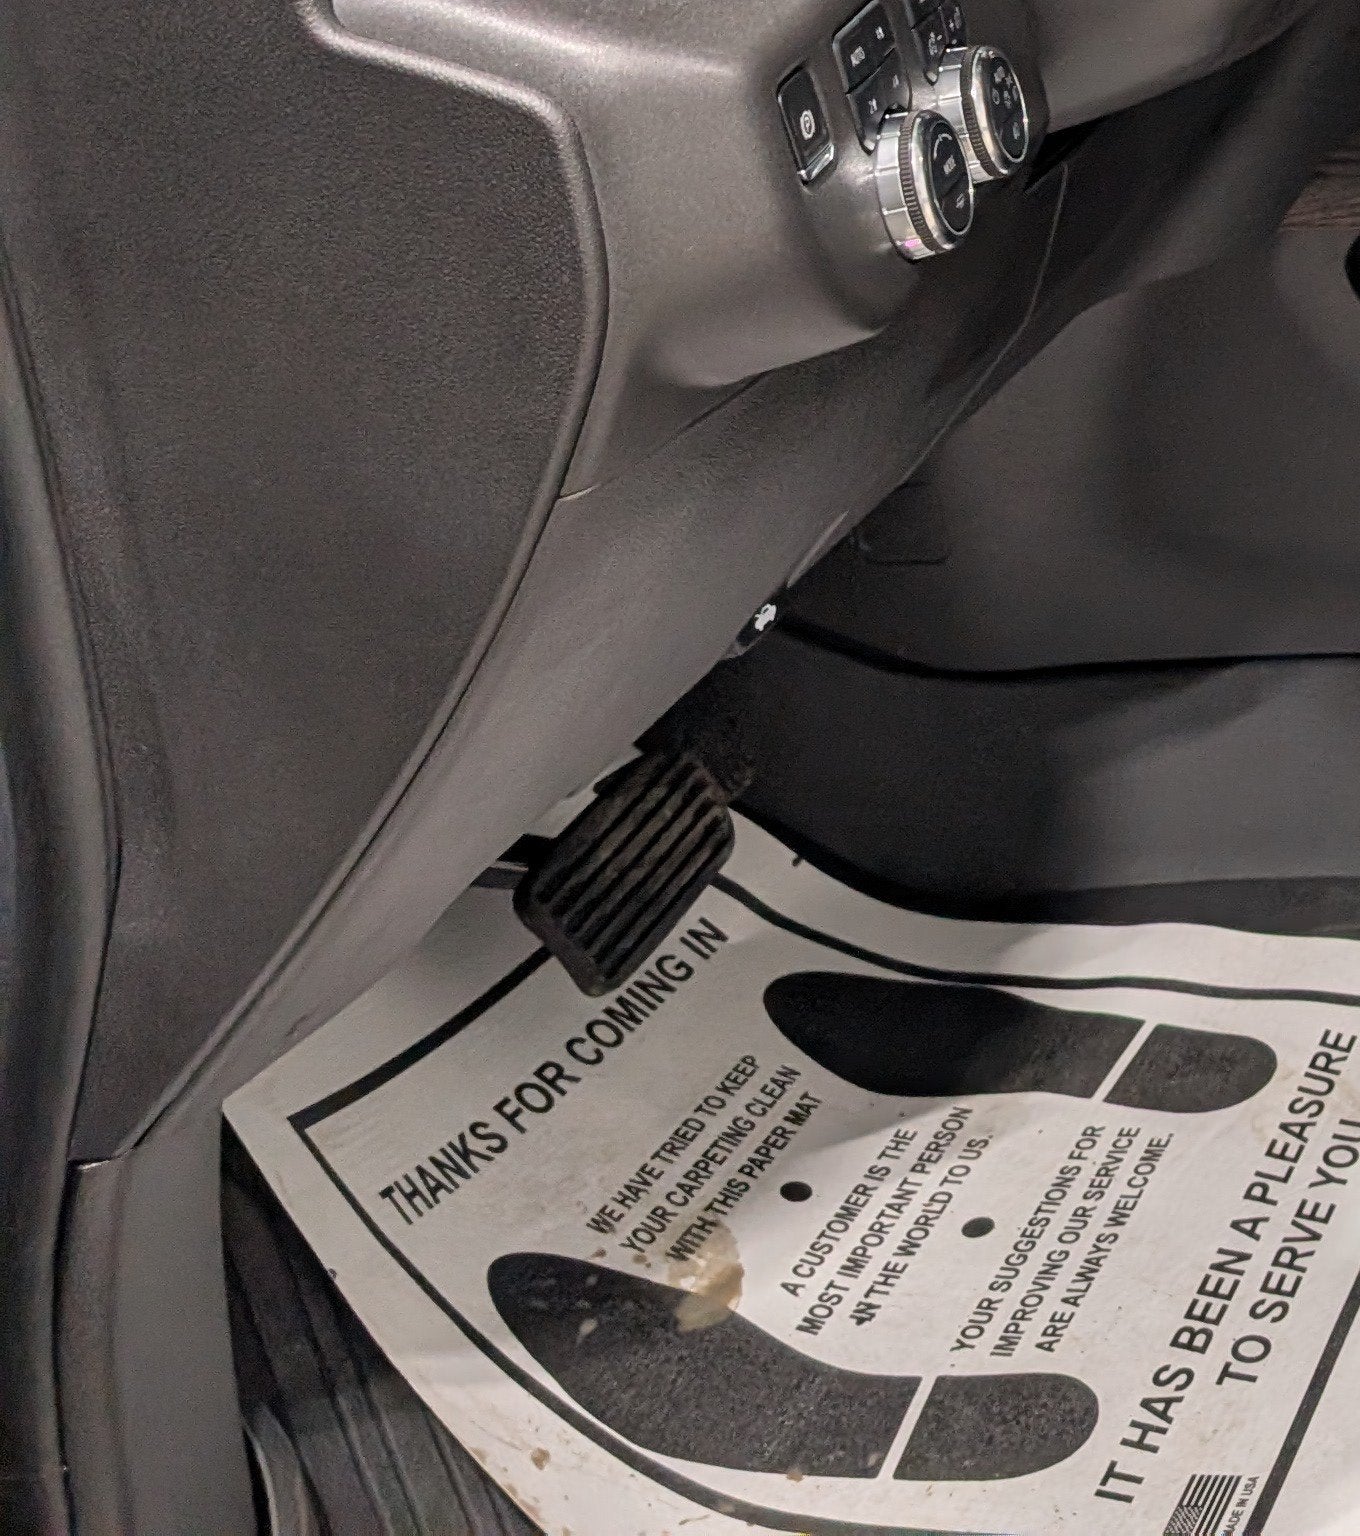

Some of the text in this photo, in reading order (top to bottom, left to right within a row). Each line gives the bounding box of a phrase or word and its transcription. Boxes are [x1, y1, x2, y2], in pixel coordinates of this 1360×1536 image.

[379, 916, 728, 1226] THANKS FOR COMING IN
[586, 1055, 759, 1235] WE HAVE TRIED TO KEEP
[619, 1065, 801, 1253] YOUR CARPETING CLEAN
[665, 1091, 823, 1262] WITH THIS PAPER MAT
[780, 1129, 918, 1297] A CUSTOMER IS THE
[795, 1107, 973, 1336] MOST IMPORTANT PERSON
[848, 1135, 994, 1326] IN THE WORLD TO US.
[950, 1125, 1106, 1352] YOUR SUGGESTIONS FOR
[990, 1126, 1141, 1357] IMPROVING OUR SERVICE
[1035, 1133, 1174, 1353] ARE ALWAYS WELCOME.
[1094, 1028, 1357, 1504] IT HAS BEEN A PLEASURE
[1215, 1335, 1272, 1385] TO
[1249, 1198, 1337, 1323] SERVE
[1241, 1476, 1260, 1495] USA
